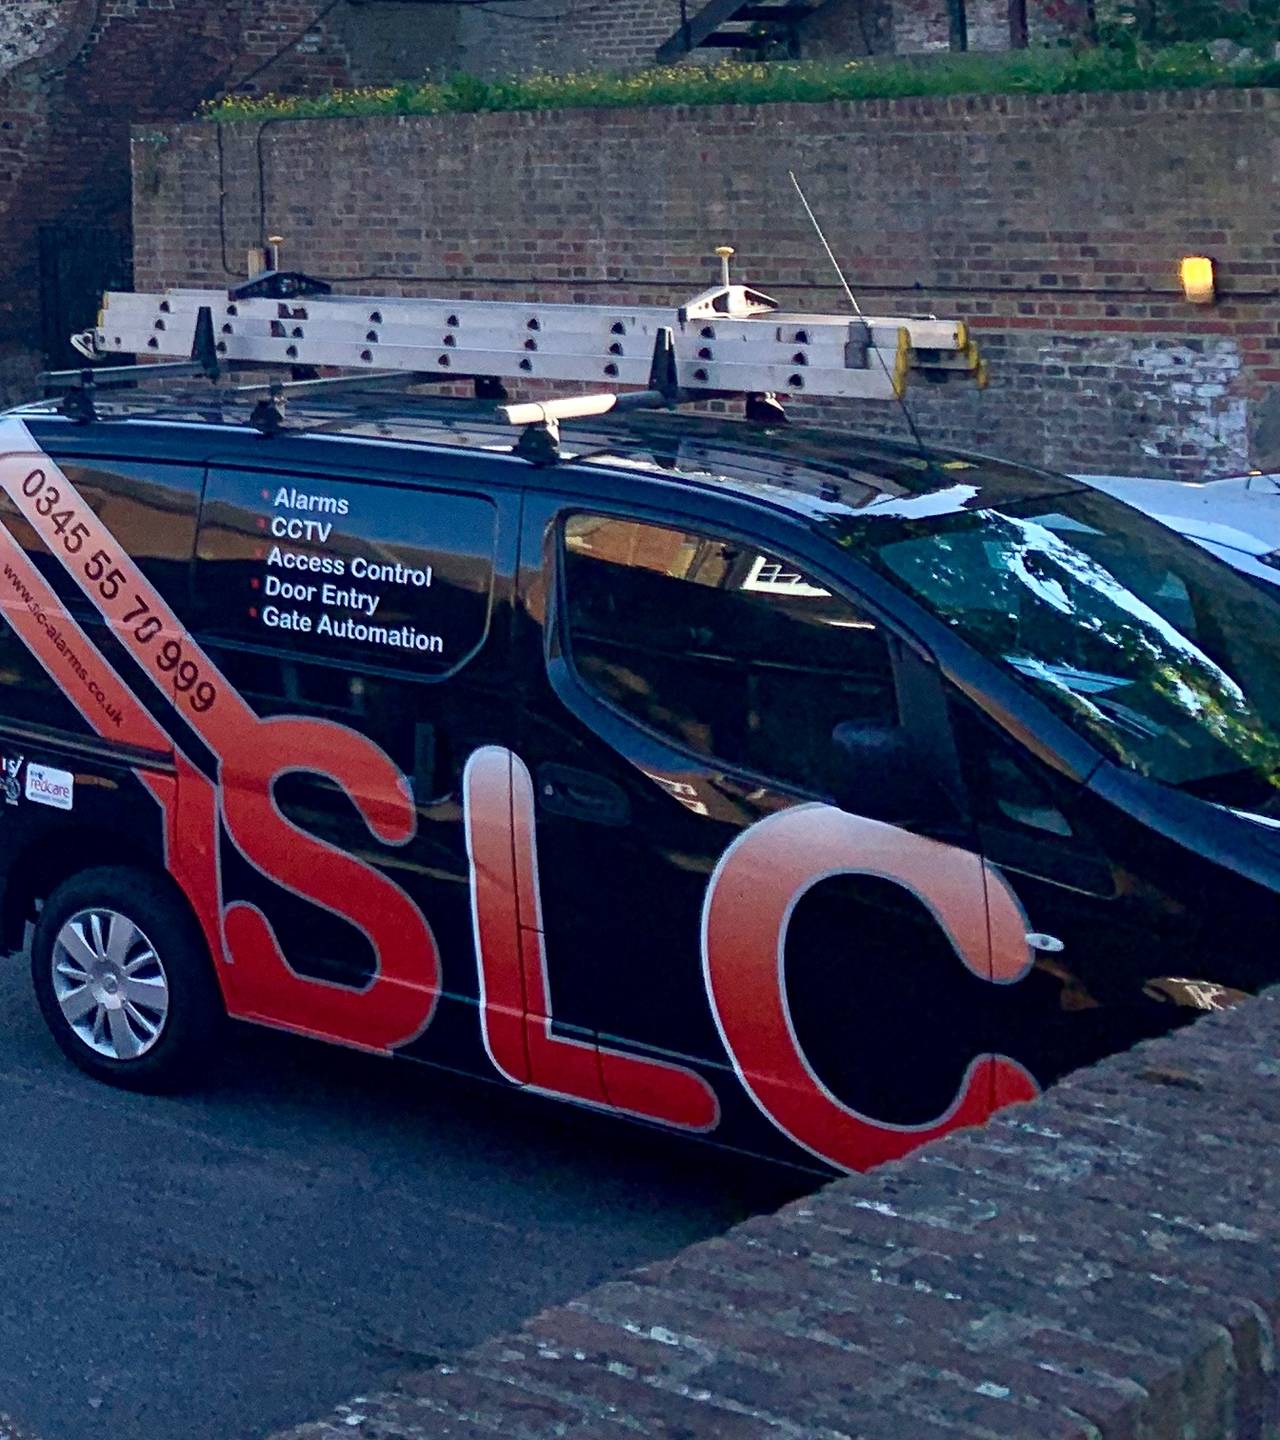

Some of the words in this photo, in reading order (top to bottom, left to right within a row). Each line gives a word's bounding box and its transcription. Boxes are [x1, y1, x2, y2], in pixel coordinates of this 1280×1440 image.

[273, 486, 350, 516] Alarms
[271, 516, 333, 543] CCTV
[267, 546, 345, 576] Access
[350, 557, 433, 588] Control
[21, 468, 91, 554] 0345
[84, 549, 127, 600] 55
[122, 594, 163, 644] 70
[156, 640, 216, 713] 999
[264, 575, 318, 602] Door
[321, 583, 380, 616] Entry
[262, 606, 312, 633] Gate
[316, 614, 444, 653] Automation
[30, 778, 70, 799] redcare
[216, 715, 1042, 1172] SLC
